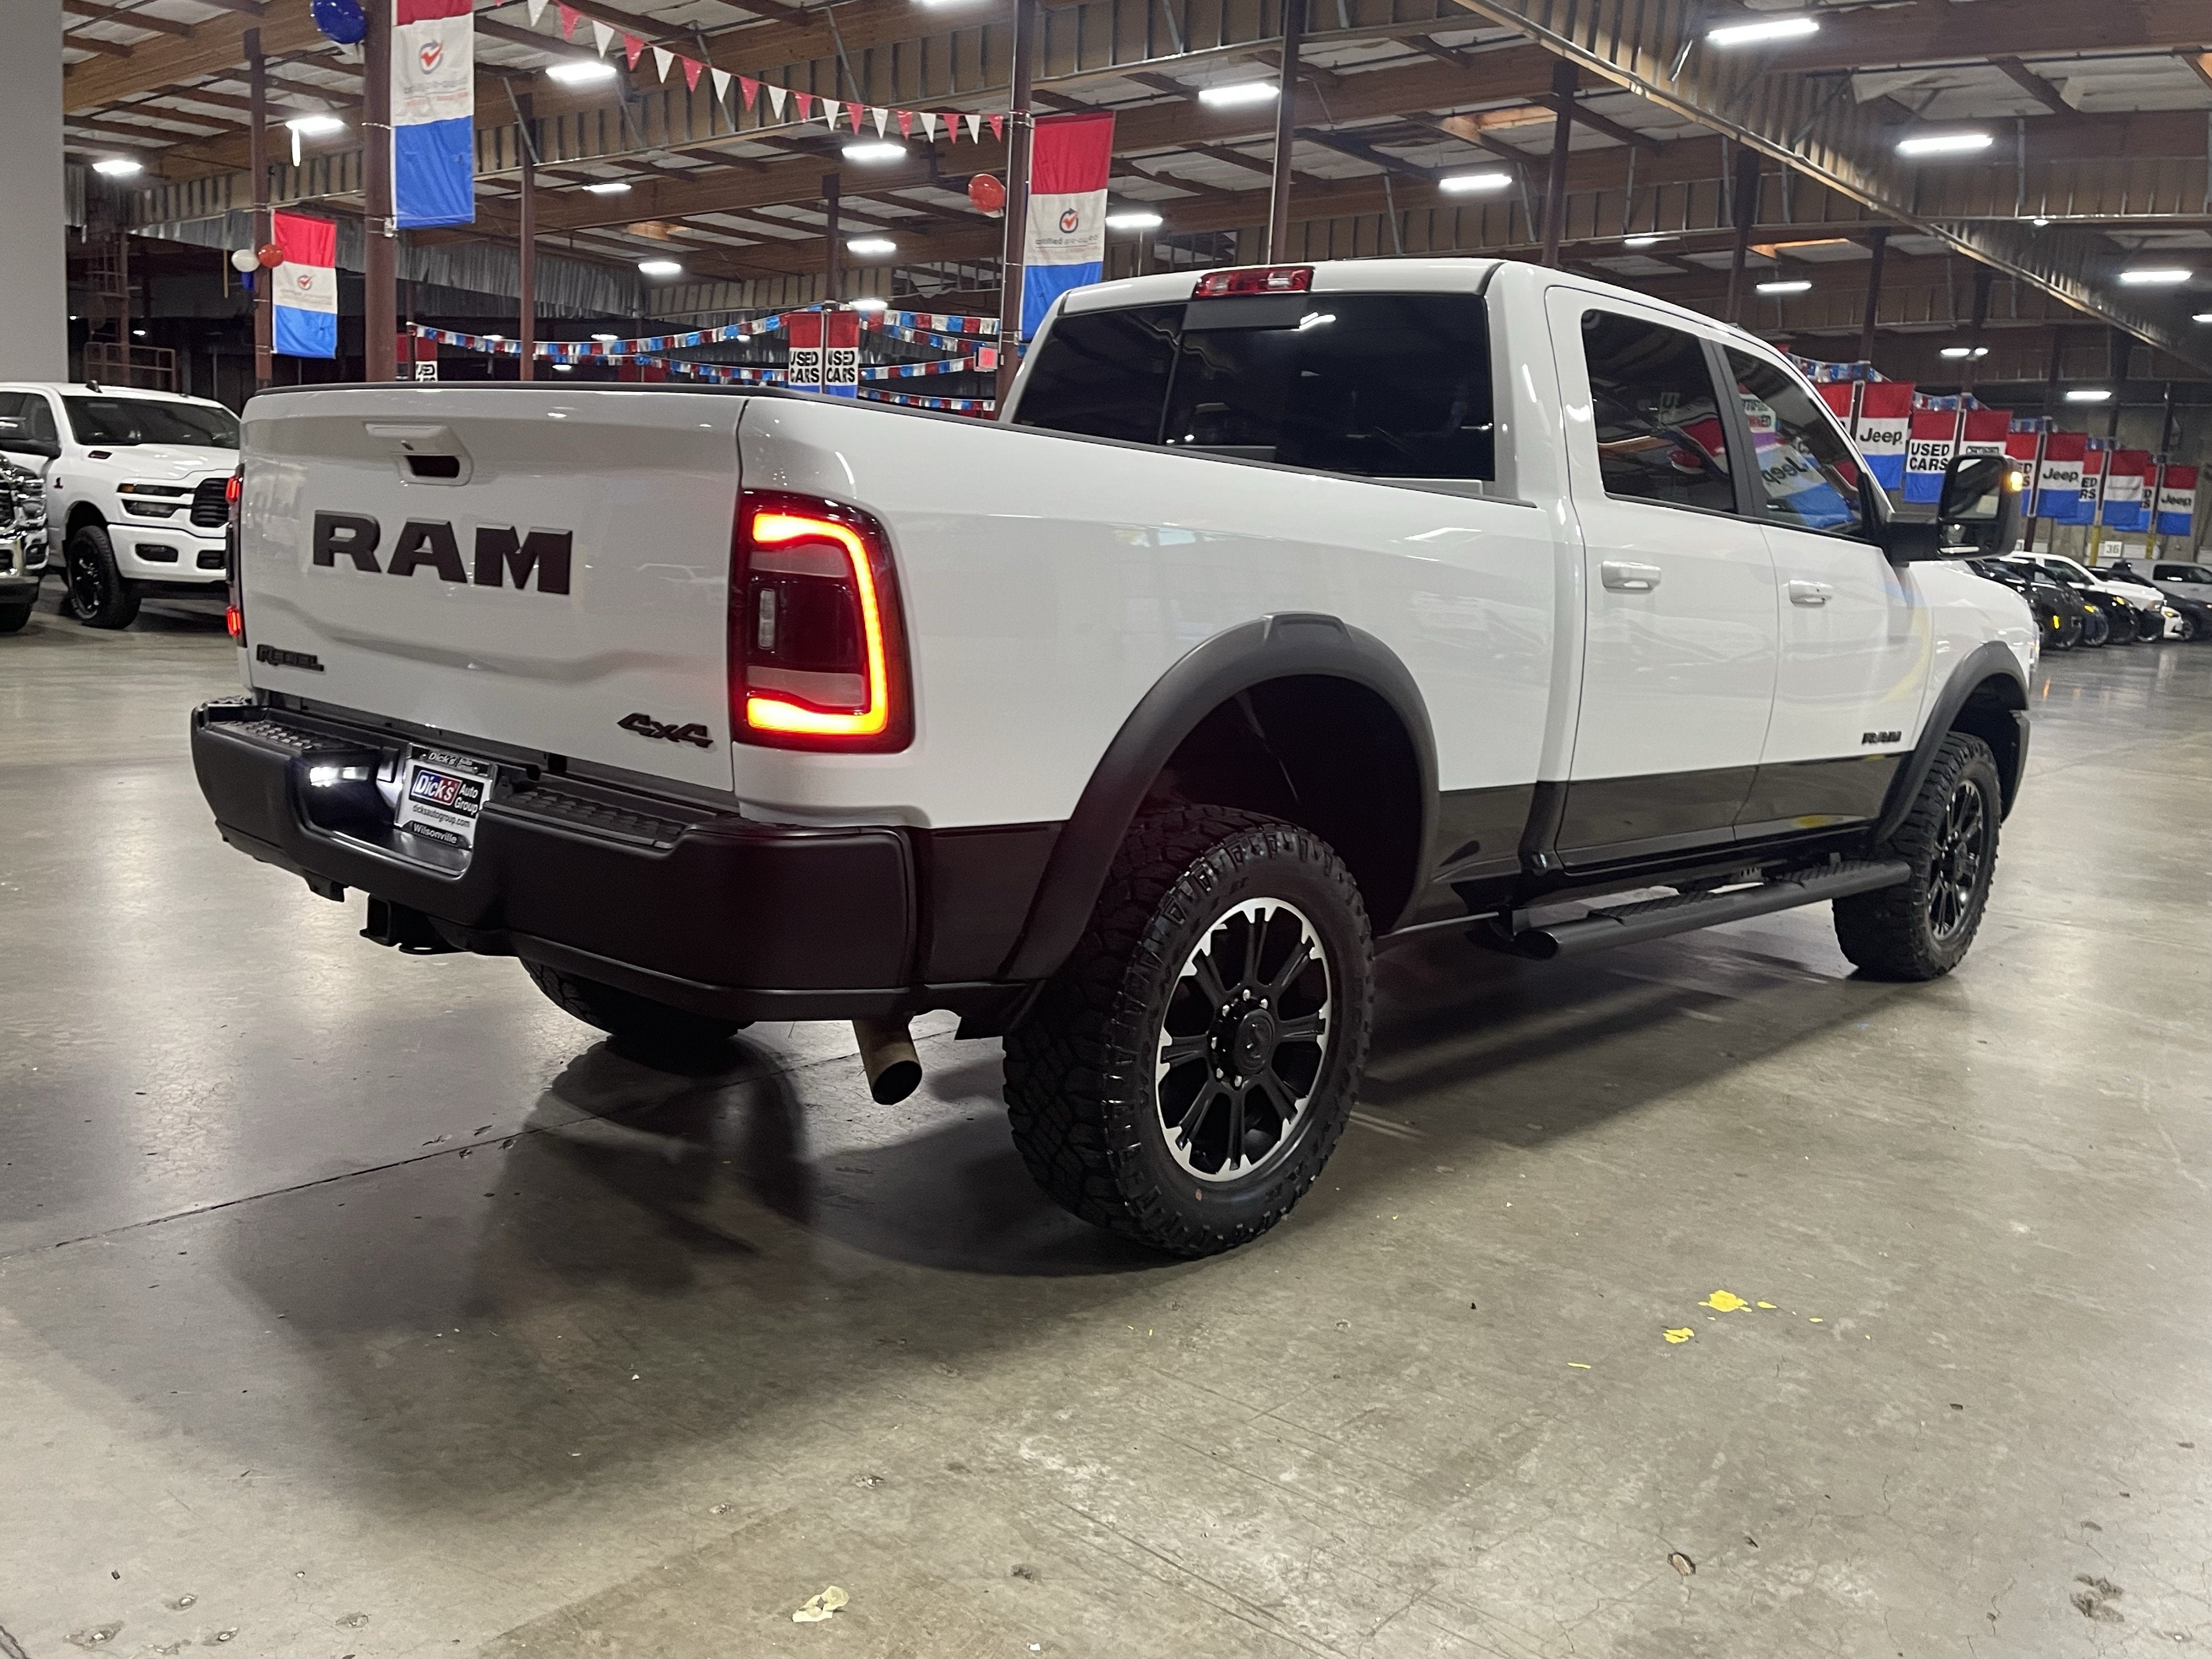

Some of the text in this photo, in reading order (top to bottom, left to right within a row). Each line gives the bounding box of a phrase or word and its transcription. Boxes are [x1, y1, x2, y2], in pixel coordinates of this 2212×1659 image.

[1860, 428, 1903, 445] Jeep
[1911, 442, 1950, 456] USED
[1909, 457, 1949, 471] CARS
[2042, 468, 2079, 482] Jeep
[313, 509, 573, 595] RAM
[428, 752, 455, 765] Dick's
[415, 775, 455, 801] Dick's
[459, 783, 478, 799] Auto
[454, 797, 478, 816] Group
[414, 823, 458, 844] Wilsonville
